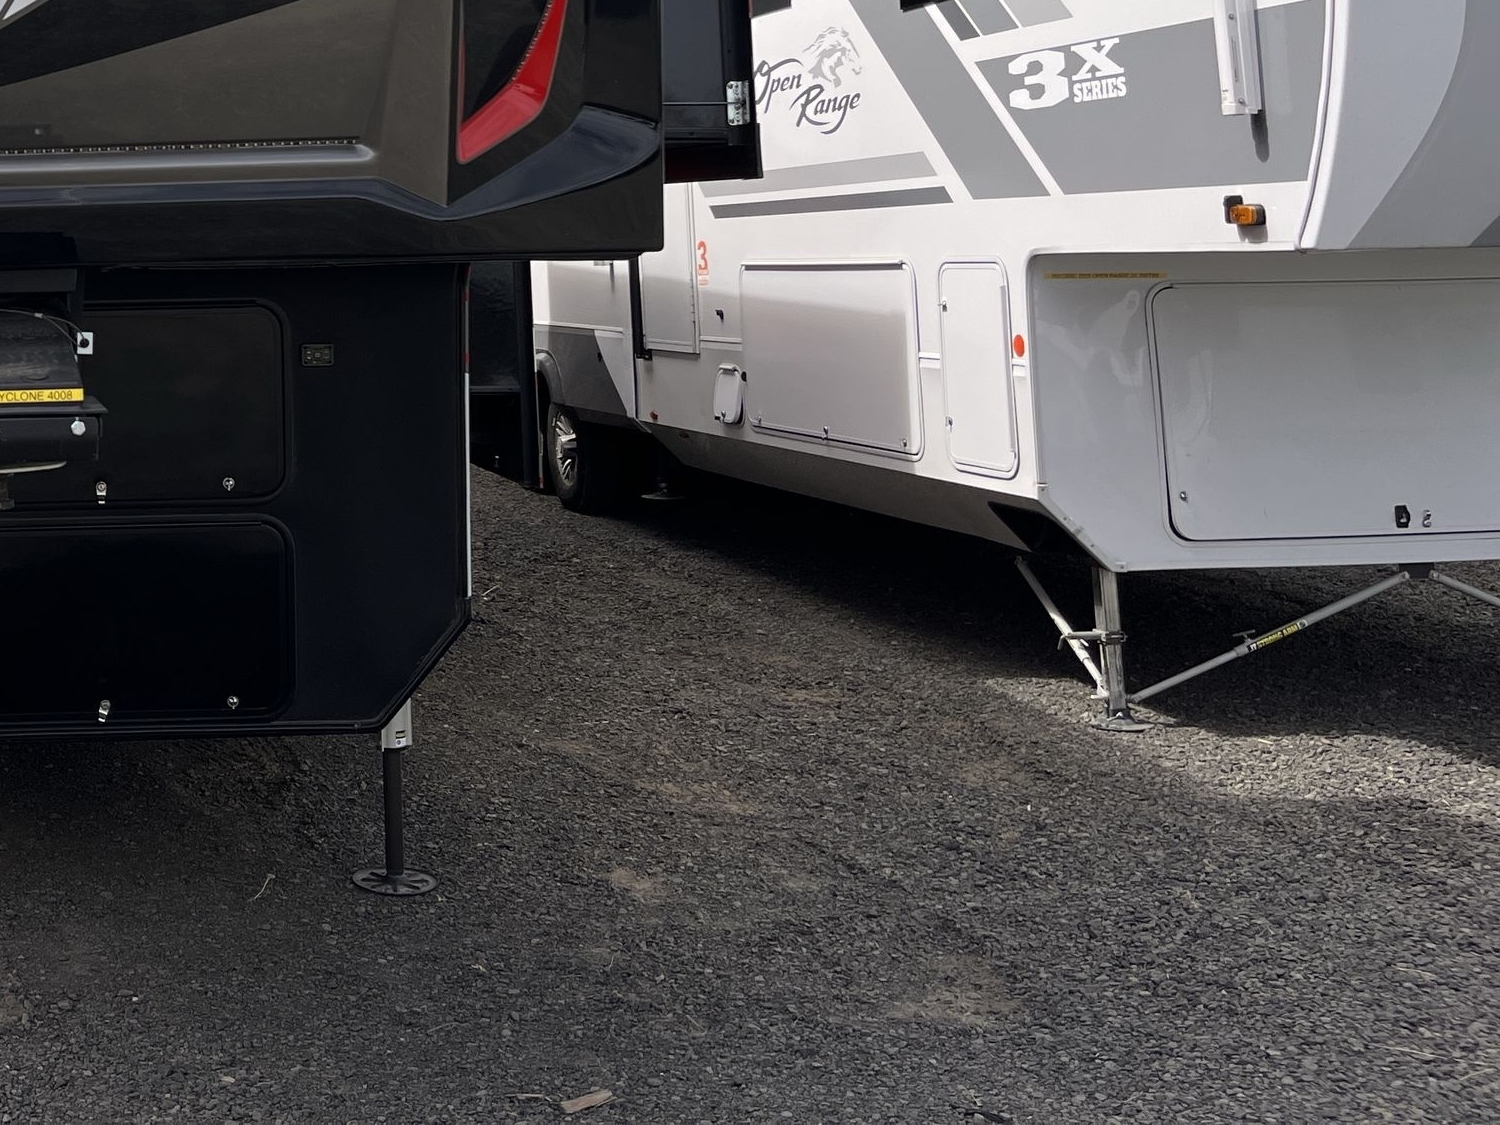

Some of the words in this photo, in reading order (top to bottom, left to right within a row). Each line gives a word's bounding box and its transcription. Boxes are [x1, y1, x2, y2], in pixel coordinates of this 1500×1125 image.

[1073, 76, 1127, 103] SERIES
[789, 84, 861, 134] Range
[697, 241, 708, 270] 3
[47, 390, 73, 400] 4008
